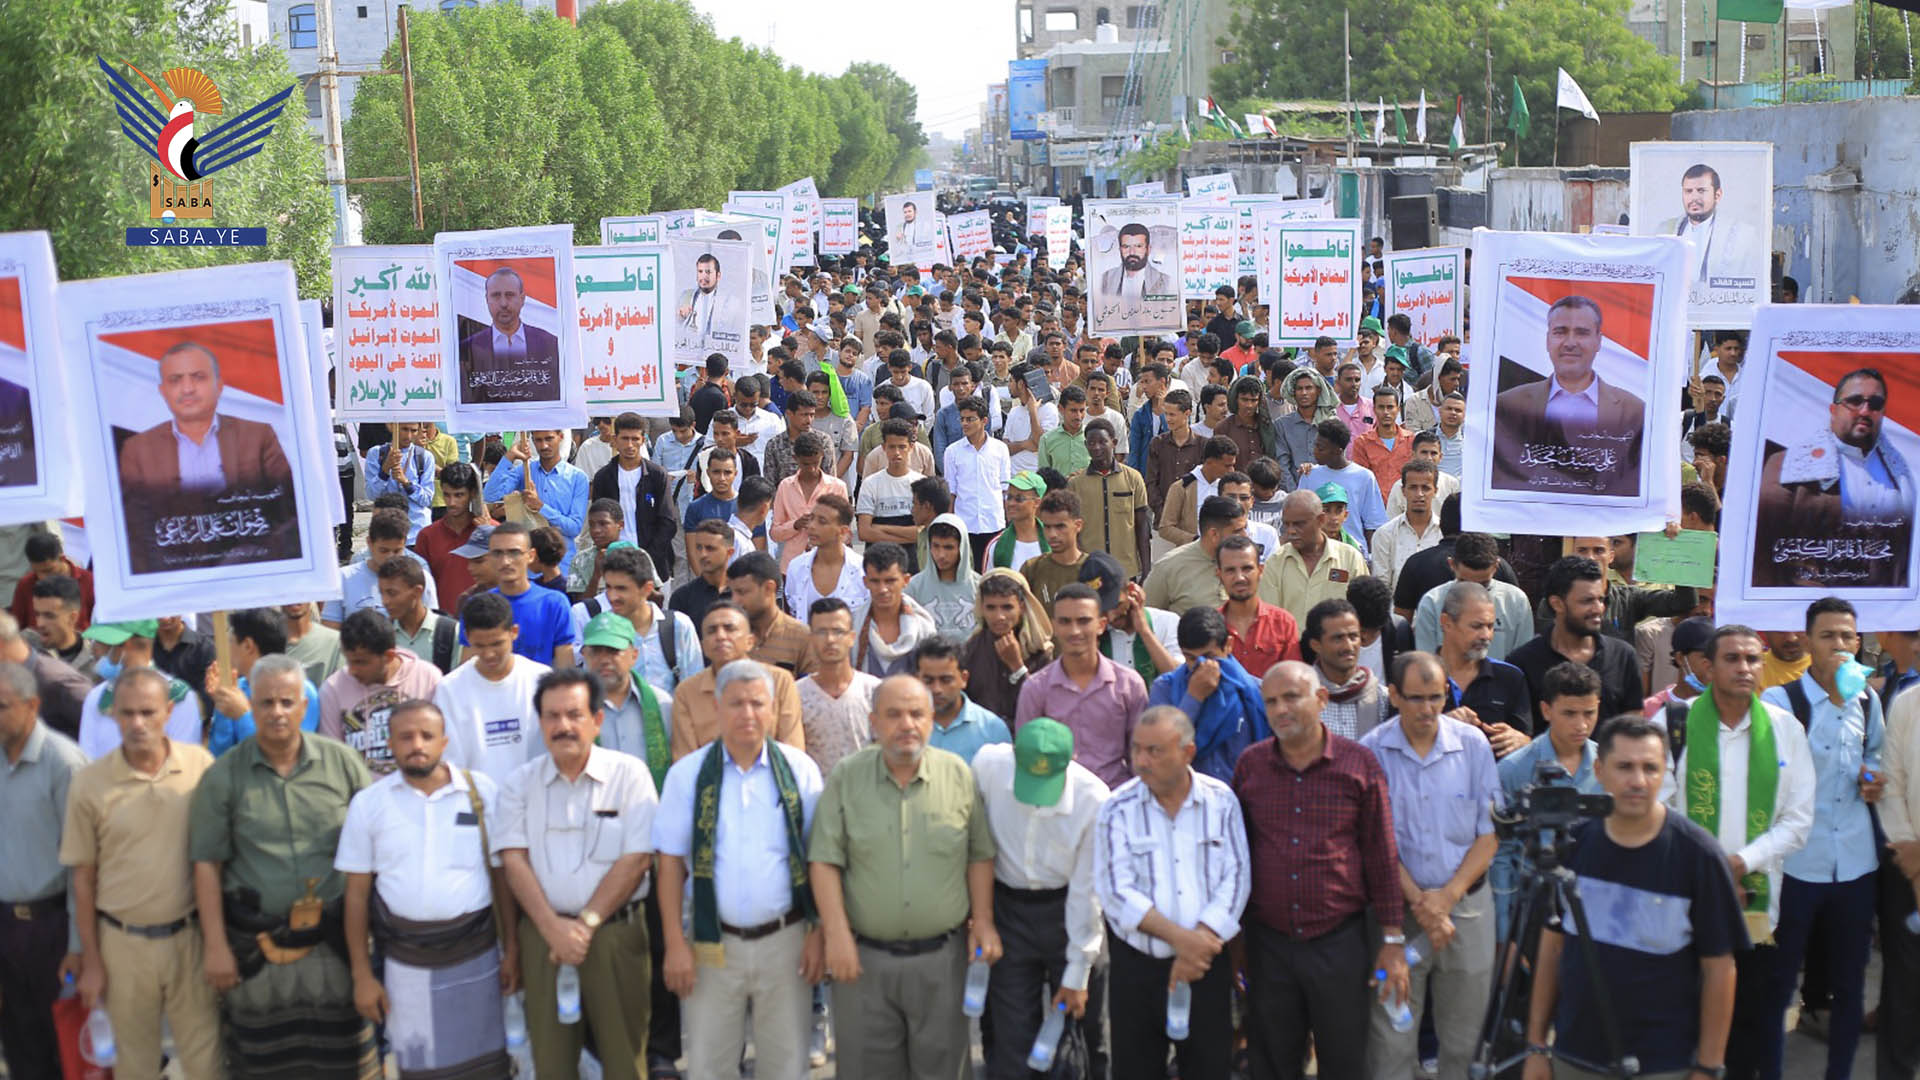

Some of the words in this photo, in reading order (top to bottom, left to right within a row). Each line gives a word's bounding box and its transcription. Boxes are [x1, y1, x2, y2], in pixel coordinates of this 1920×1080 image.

[1182, 214, 1213, 234] أكبر
[1214, 216, 1233, 231] الله
[1285, 239, 1350, 262] قاطعوا
[346, 263, 404, 298] أكبر
[404, 265, 438, 291] الله
[575, 266, 654, 299] قاطعو
[1283, 265, 1319, 287] الأمريكية
[1319, 267, 1349, 287] البضائع
[1395, 263, 1454, 289] قاطعوا
[1312, 290, 1319, 305] و
[399, 301, 440, 321] الموت
[616, 305, 654, 331] البضائع
[1421, 312, 1427, 325] و
[400, 328, 441, 347] الموت
[607, 336, 614, 357] و
[349, 353, 384, 373] اليهود
[387, 354, 407, 373] على
[411, 352, 442, 370] اللعنة
[350, 378, 398, 408] للإسلام
[400, 377, 443, 407] النصر
